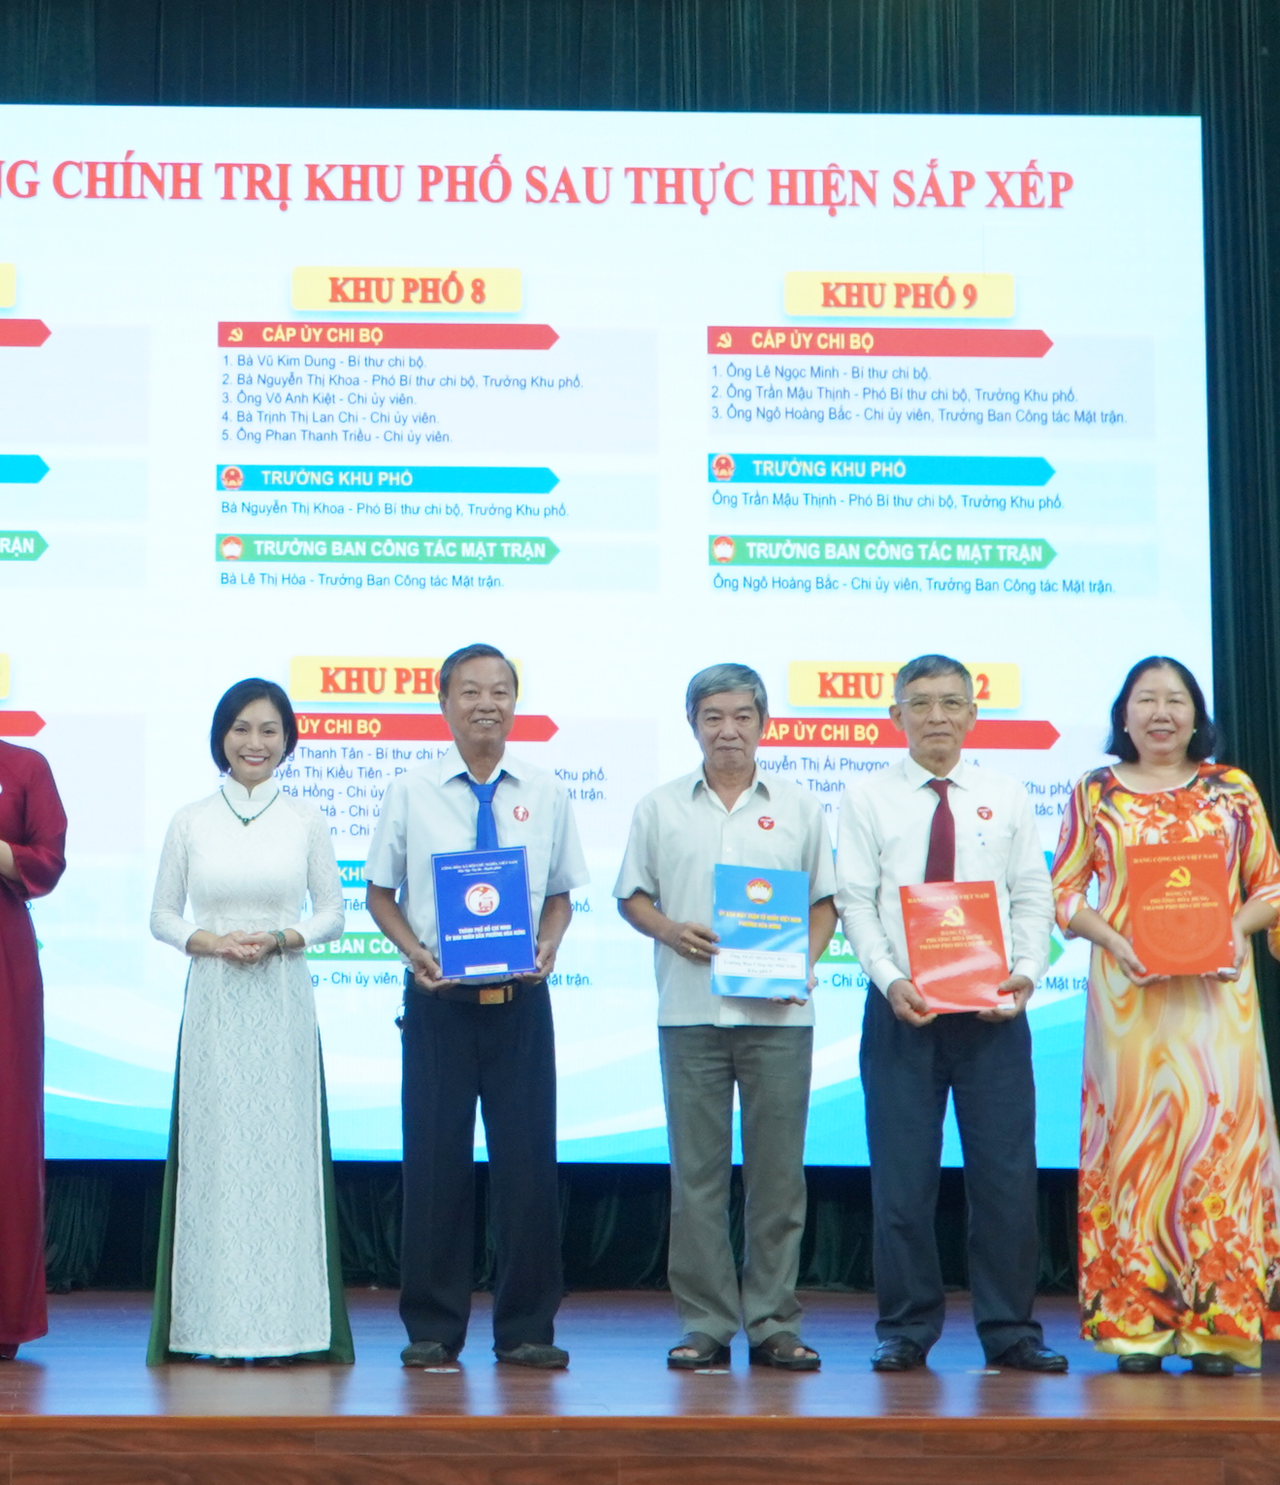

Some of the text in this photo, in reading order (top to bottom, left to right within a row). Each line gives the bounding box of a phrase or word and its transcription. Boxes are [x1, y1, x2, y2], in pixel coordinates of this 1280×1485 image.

[53, 150, 202, 200] CHÍNH
[215, 163, 291, 211] TRỊ
[305, 164, 405, 202] KHU
[418, 154, 512, 203] PHỐ
[526, 166, 613, 204] SAU
[624, 162, 753, 215] THỰC
[768, 163, 879, 217] HIỆN
[893, 159, 975, 207] SẮP
[986, 160, 1073, 208] XẾP
[329, 271, 486, 304] KHU PHỐ 8
[821, 276, 977, 309] KHU PHỐ 9
[262, 325, 383, 346] CẤP ỦY CHI BỘ
[751, 331, 874, 353] CẤP ỦY CHI BỘ
[237, 373, 253, 385] Bà
[257, 372, 302, 388] Nguyễn
[307, 374, 324, 387] Thị
[329, 374, 360, 386] Khoa
[372, 374, 395, 386] Phó
[400, 374, 411, 386] Bí
[416, 375, 435, 386] thư
[439, 376, 456, 386] chi
[461, 375, 478, 388] bộ,
[483, 375, 526, 390] Trưởng
[531, 376, 554, 388] Khu
[558, 373, 584, 391] phố.
[727, 403, 752, 421] Ông
[757, 406, 781, 422] Ngô
[785, 408, 824, 422] Hoàng
[829, 405, 852, 420] Bắc
[864, 407, 883, 421] Chi
[888, 407, 902, 423] ủy
[906, 408, 934, 422] viên,
[938, 408, 983, 424] Trưởng
[988, 409, 1011, 422] Ban
[1016, 409, 1048, 424] Công
[1052, 410, 1070, 423] tác
[1074, 410, 1096, 425] Mặt
[1100, 410, 1127, 425] trận.
[254, 538, 545, 561] TRƯỞNG BAN CÔNG TÁC MẶT TRẬN
[746, 540, 1042, 565] TRƯỞNG BAN CÔNG TÁC MẶT TRẬN
[320, 667, 387, 694] KHU
[818, 672, 883, 699] KHU
[298, 717, 381, 737] ỦY CHI BỘ
[794, 720, 879, 745] ỦY CHI BỘ
[299, 747, 433, 760] Thanh Tân Bí thư chi
[304, 766, 382, 780] Thị Kiều Tiên
[800, 757, 819, 773] Thị
[580, 789, 607, 802] trận.
[330, 939, 364, 954] BAN
[331, 972, 401, 987] Chi ủy viên,
